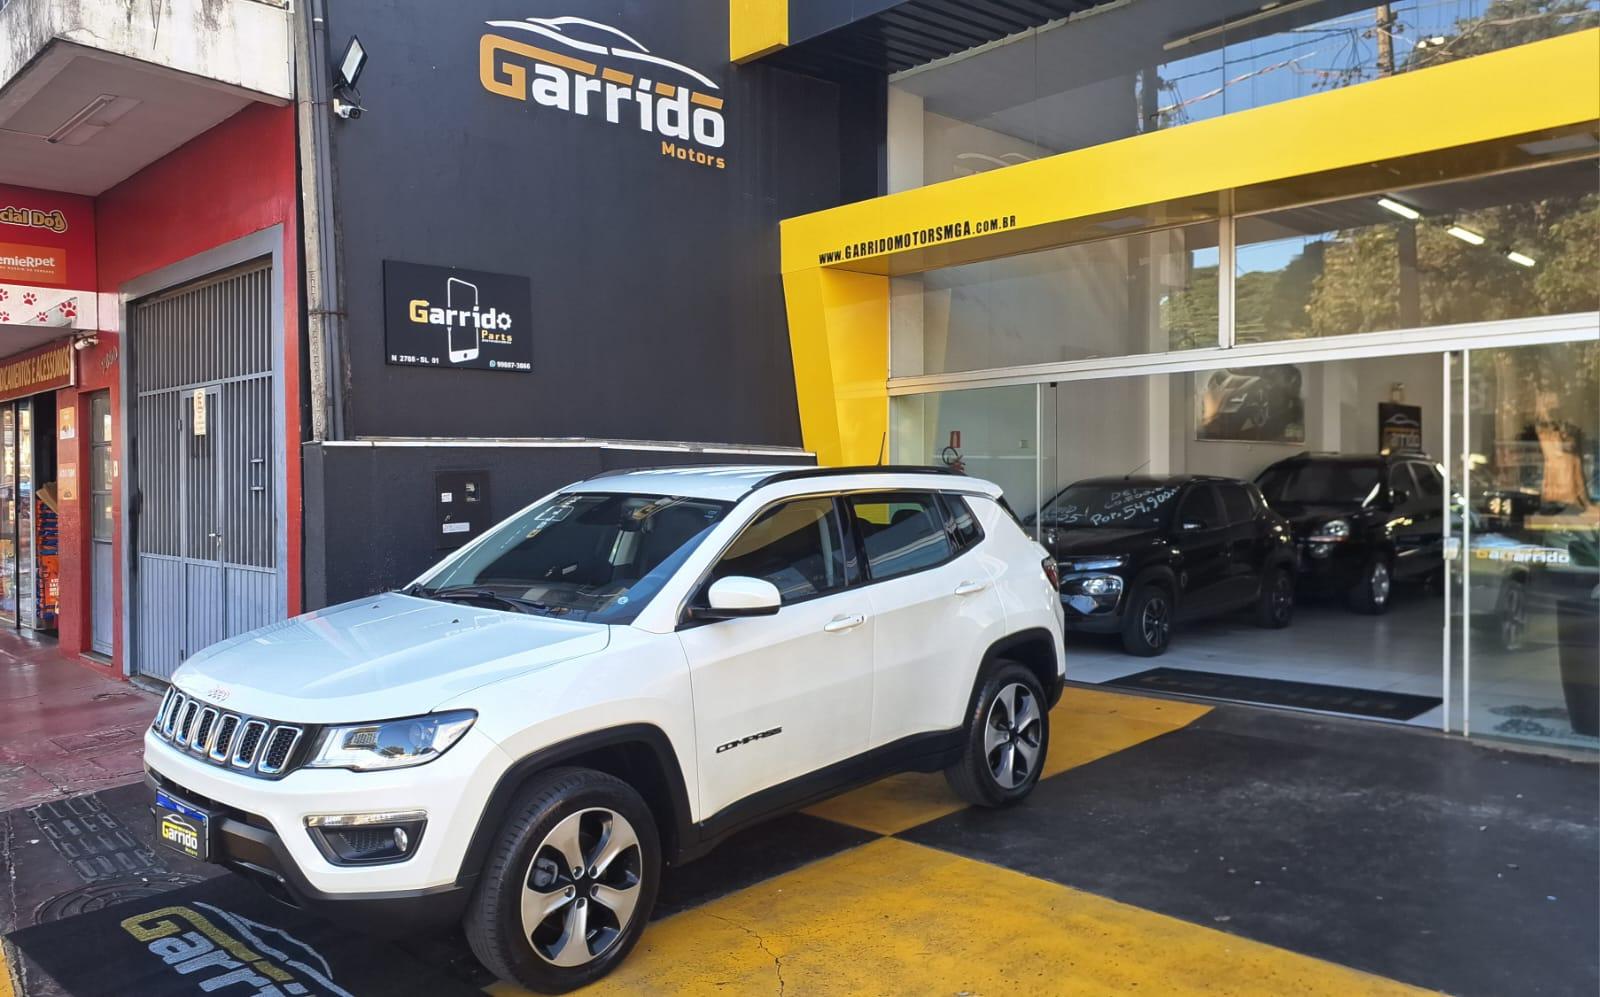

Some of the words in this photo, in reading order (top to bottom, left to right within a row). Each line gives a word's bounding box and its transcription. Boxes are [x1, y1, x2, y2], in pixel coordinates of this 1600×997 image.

[480, 33, 725, 148] Garrido
[661, 141, 726, 169] Motors
[32, 210, 66, 231] Dog
[409, 299, 512, 330] Garrido
[481, 330, 513, 342] Parts
[32, 357, 37, 385] E
[161, 820, 198, 851] Garrido
